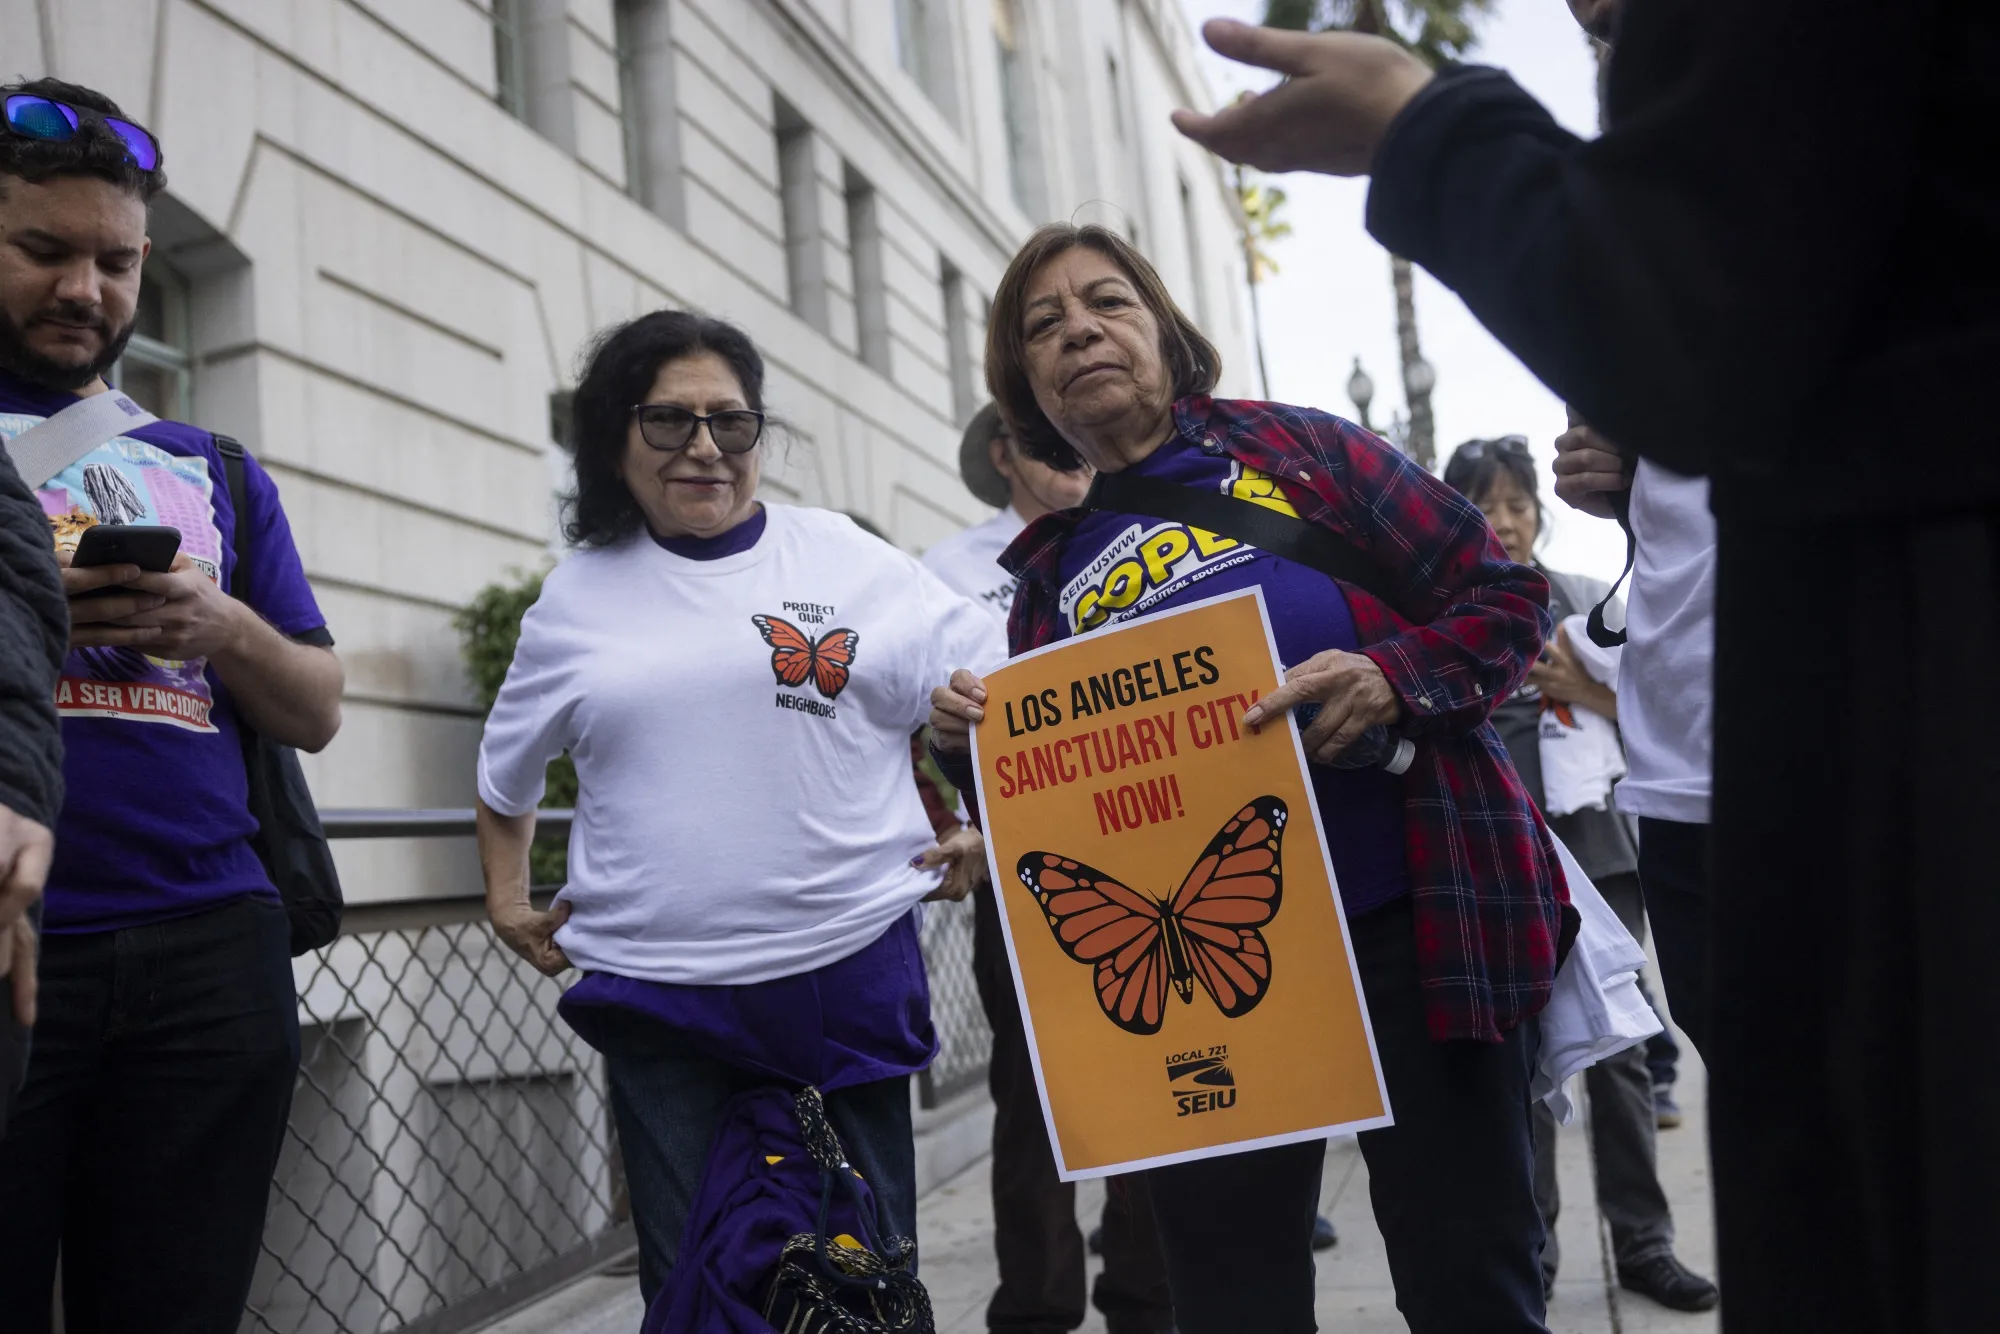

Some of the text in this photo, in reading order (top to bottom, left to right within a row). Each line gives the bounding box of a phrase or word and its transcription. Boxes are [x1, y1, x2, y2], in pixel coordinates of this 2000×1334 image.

[1062, 530, 1136, 605] SEIU-USWW
[1139, 580, 1190, 611] POLITICAL
[1191, 553, 1255, 582] EDUCATION
[782, 601, 835, 616] PROTECT
[798, 612, 825, 625] OUR
[79, 682, 123, 708] SER
[775, 692, 836, 719] NEIGHBORS
[1004, 645, 1220, 738] LOS ANGELES
[995, 711, 1178, 799] SANCTUARY
[1093, 773, 1186, 836] NOW!
[1165, 1044, 1228, 1065] LOCAL 721
[1177, 1088, 1237, 1117] SEIU
